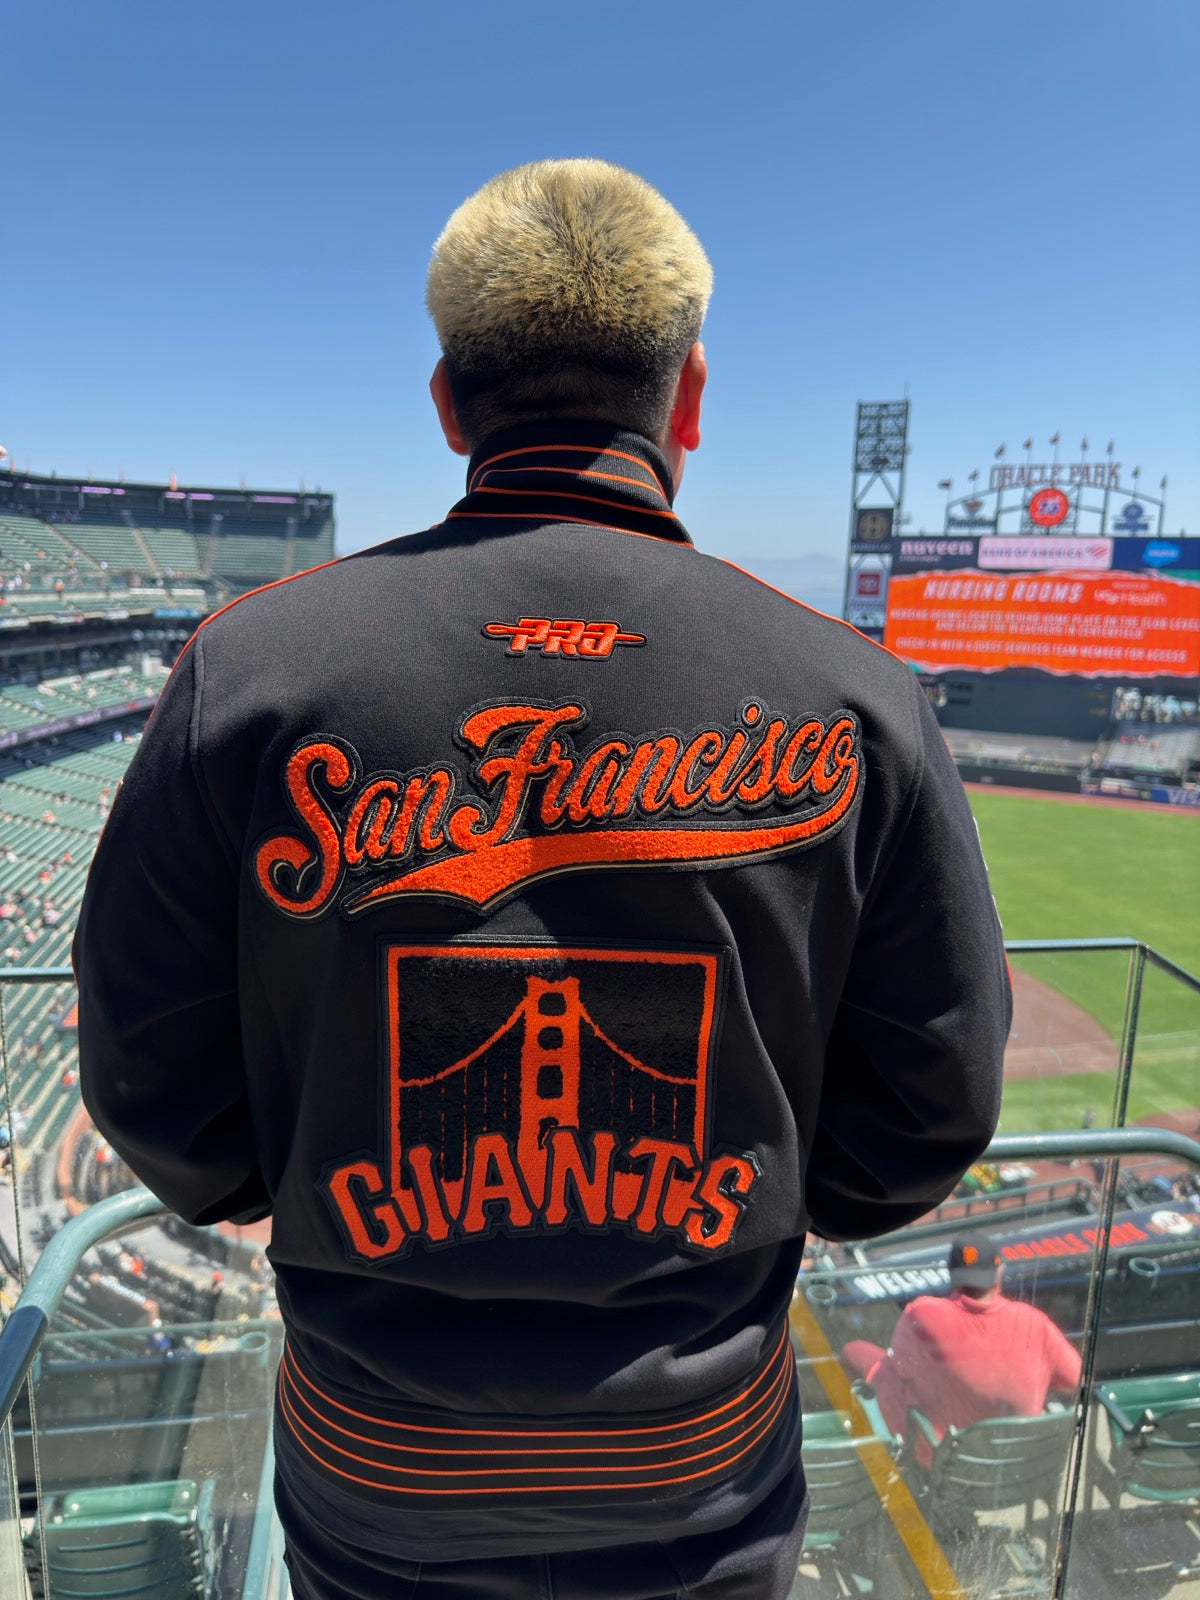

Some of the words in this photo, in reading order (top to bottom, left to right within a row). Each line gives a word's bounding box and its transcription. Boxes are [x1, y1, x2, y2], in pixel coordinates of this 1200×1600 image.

[989, 464, 1063, 490] ORACLE
[1068, 461, 1121, 490] PARK
[901, 541, 974, 556] nuveen
[1031, 548, 1082, 560] AMERICA
[923, 579, 1008, 601] NURSING
[1011, 581, 1084, 604] ROOMS
[506, 616, 621, 659] PRO
[254, 738, 453, 916] San
[443, 700, 860, 850] Francisco
[328, 1125, 758, 1260] GIANTS
